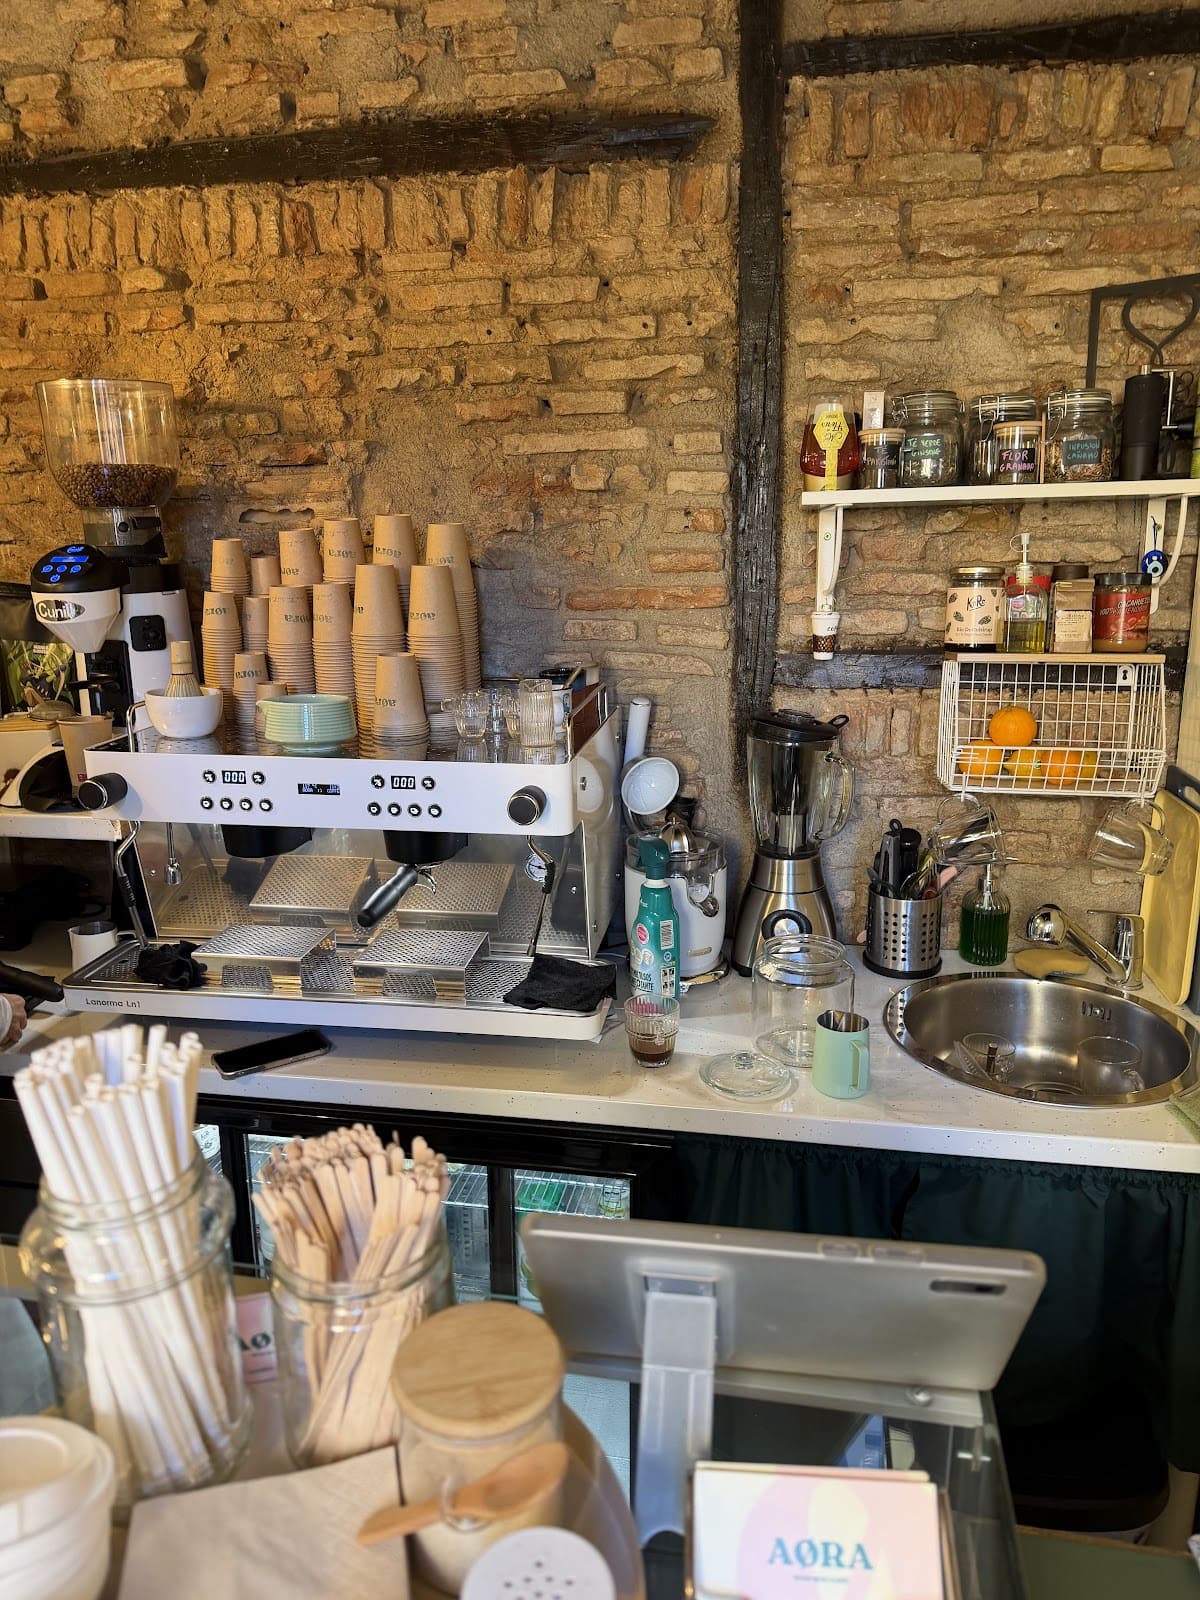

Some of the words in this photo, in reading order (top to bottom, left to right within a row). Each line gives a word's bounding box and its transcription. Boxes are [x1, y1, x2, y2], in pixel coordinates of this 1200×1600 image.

[1001, 449, 1029, 461] FLOR
[223, 771, 246, 783] 000
[392, 777, 414, 788] 000
[85, 997, 124, 1008] Lanorma
